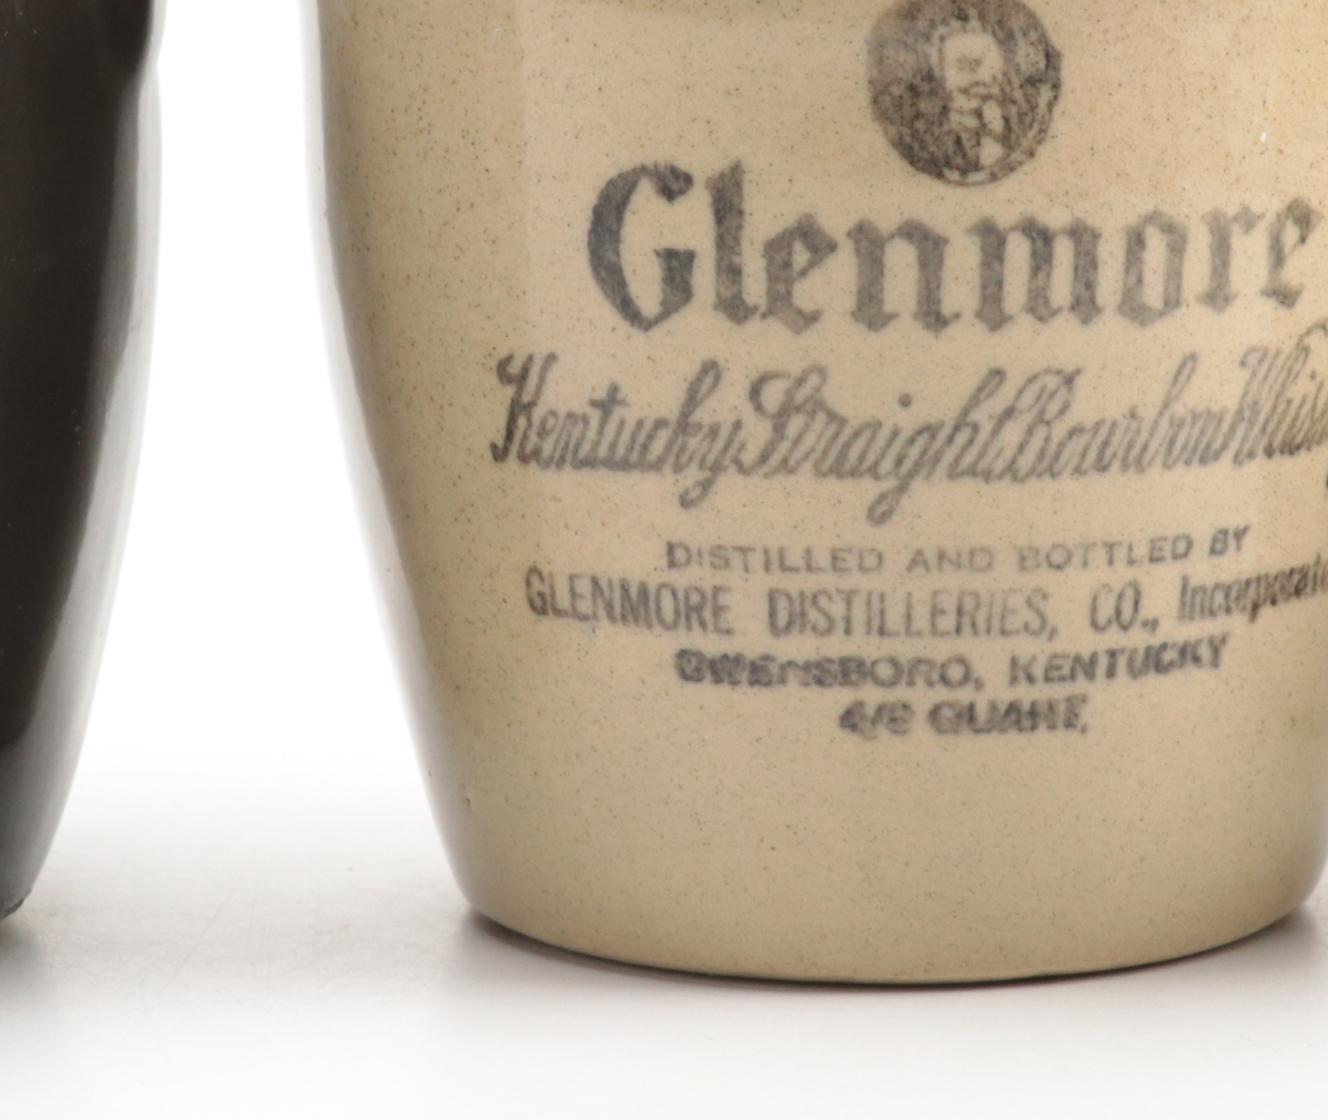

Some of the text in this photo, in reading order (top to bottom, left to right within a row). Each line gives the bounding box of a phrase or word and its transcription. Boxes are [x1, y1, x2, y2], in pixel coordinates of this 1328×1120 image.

[586, 159, 1325, 334] Glenmore
[489, 352, 744, 510] Kentucky
[734, 364, 1017, 526] Straight
[1000, 353, 1230, 482] Bourbon
[665, 524, 1252, 574] DISTILLED AND BOTTLED BY
[524, 564, 734, 637] GLENMORE
[768, 586, 1059, 642] DISTILLERIES,
[1010, 632, 1231, 688] KENTUCKY
